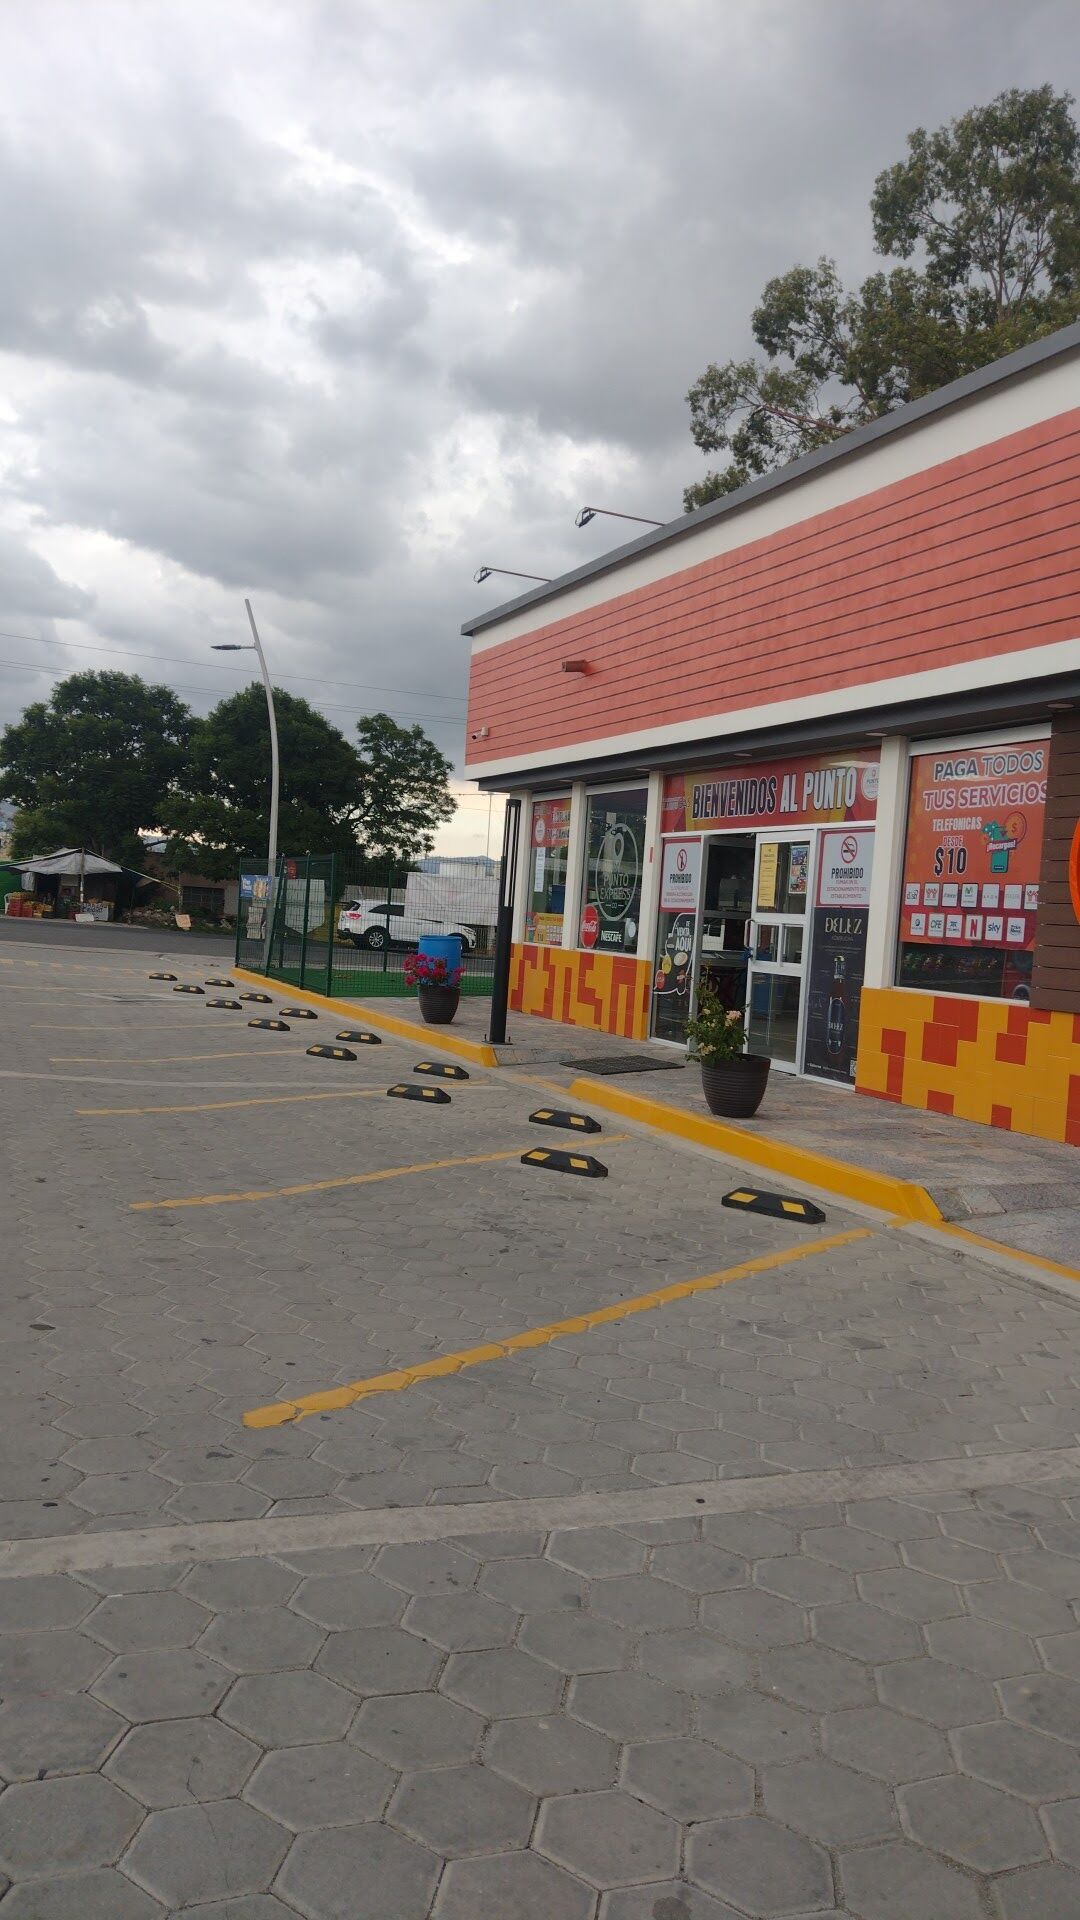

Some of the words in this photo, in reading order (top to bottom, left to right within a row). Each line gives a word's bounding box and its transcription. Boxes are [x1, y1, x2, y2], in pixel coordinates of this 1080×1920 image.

[933, 758, 979, 782] PAGA
[982, 750, 1044, 776] TODOS
[692, 776, 777, 819] BIENVENIDOS
[779, 774, 798, 813] AL
[802, 767, 858, 811] PUNTO
[923, 789, 955, 811] TUS
[959, 780, 1047, 809] SERVICIOS
[932, 816, 982, 832] TELEFONICAS
[943, 836, 963, 847] DESDE
[934, 846, 967, 877] $10
[603, 873, 629, 887] PUNTO
[831, 867, 864, 879] PROHIBIDO
[600, 887, 631, 900] EXPRESS
[988, 922, 1000, 934] sky
